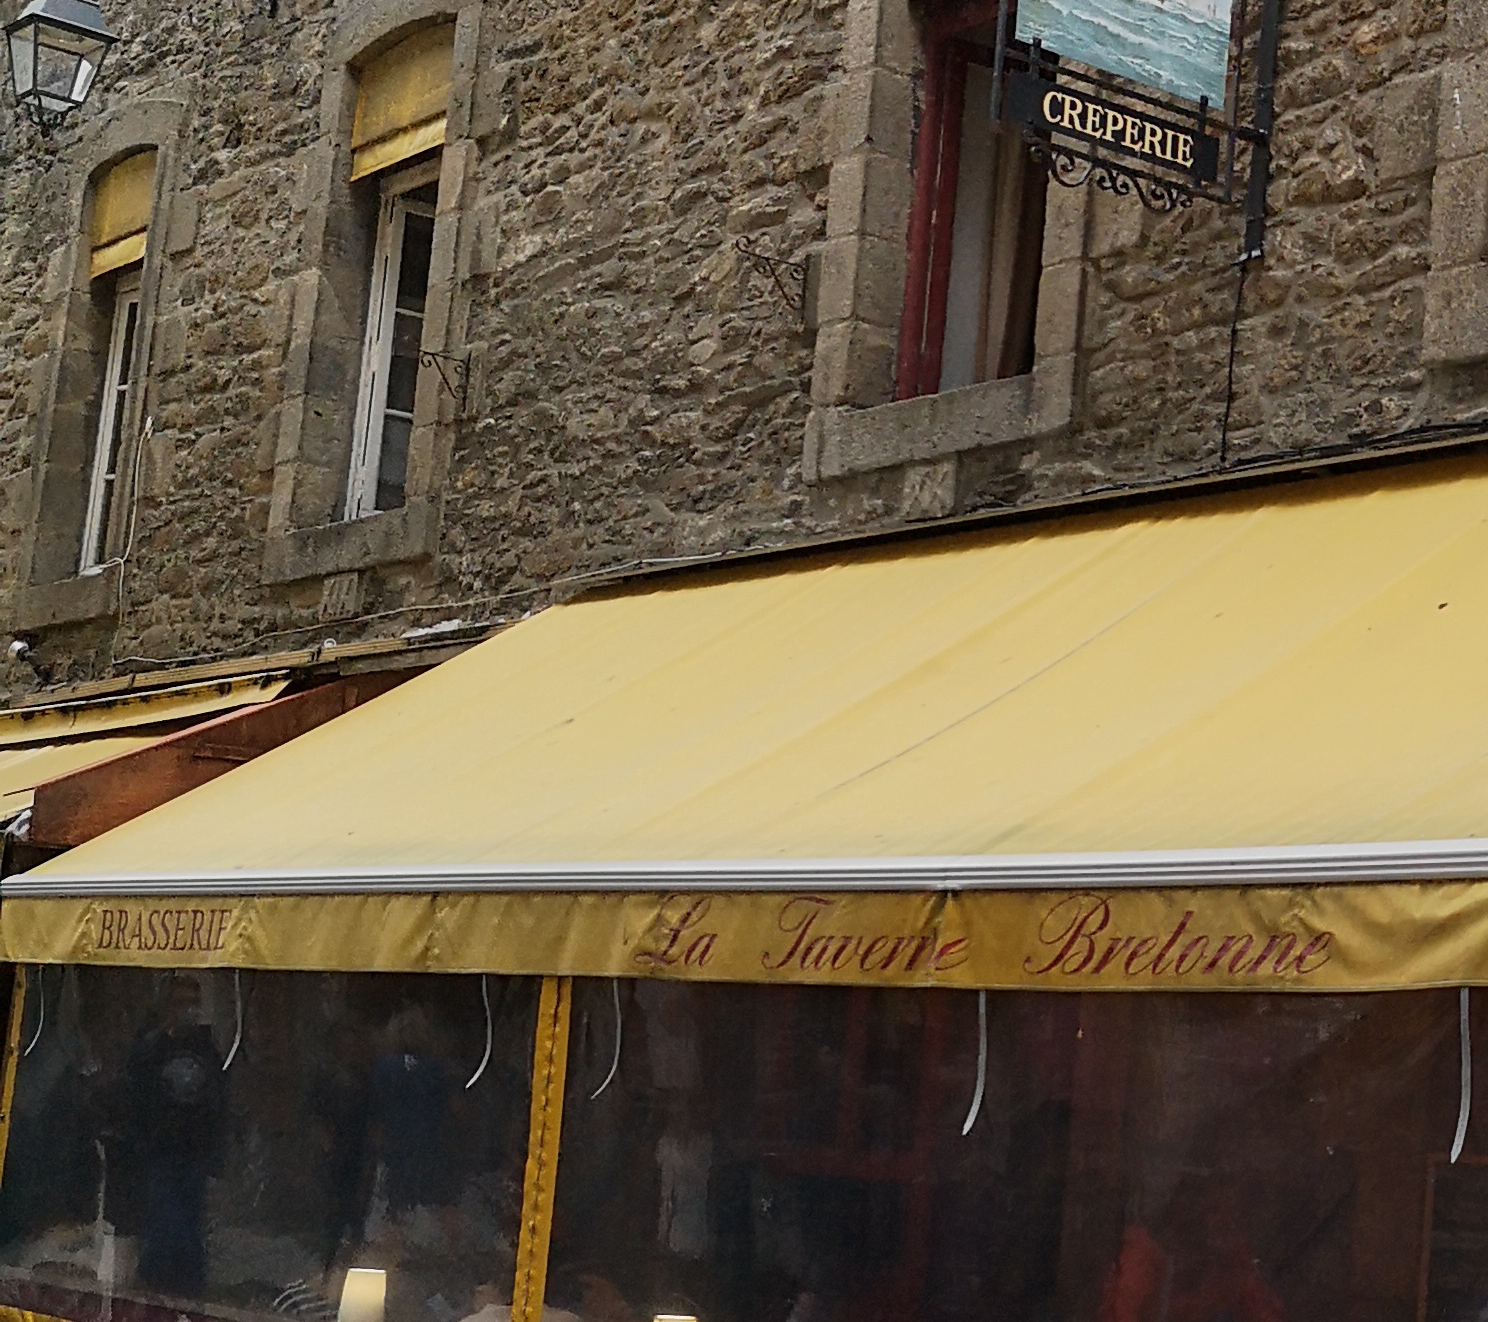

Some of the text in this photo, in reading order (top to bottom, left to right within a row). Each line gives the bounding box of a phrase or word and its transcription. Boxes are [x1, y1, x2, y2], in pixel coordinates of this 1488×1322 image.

[1042, 90, 1195, 168] CREPERIE
[99, 907, 233, 952] BRASSERIE
[633, 891, 1333, 976] La Taverne Bretonne
